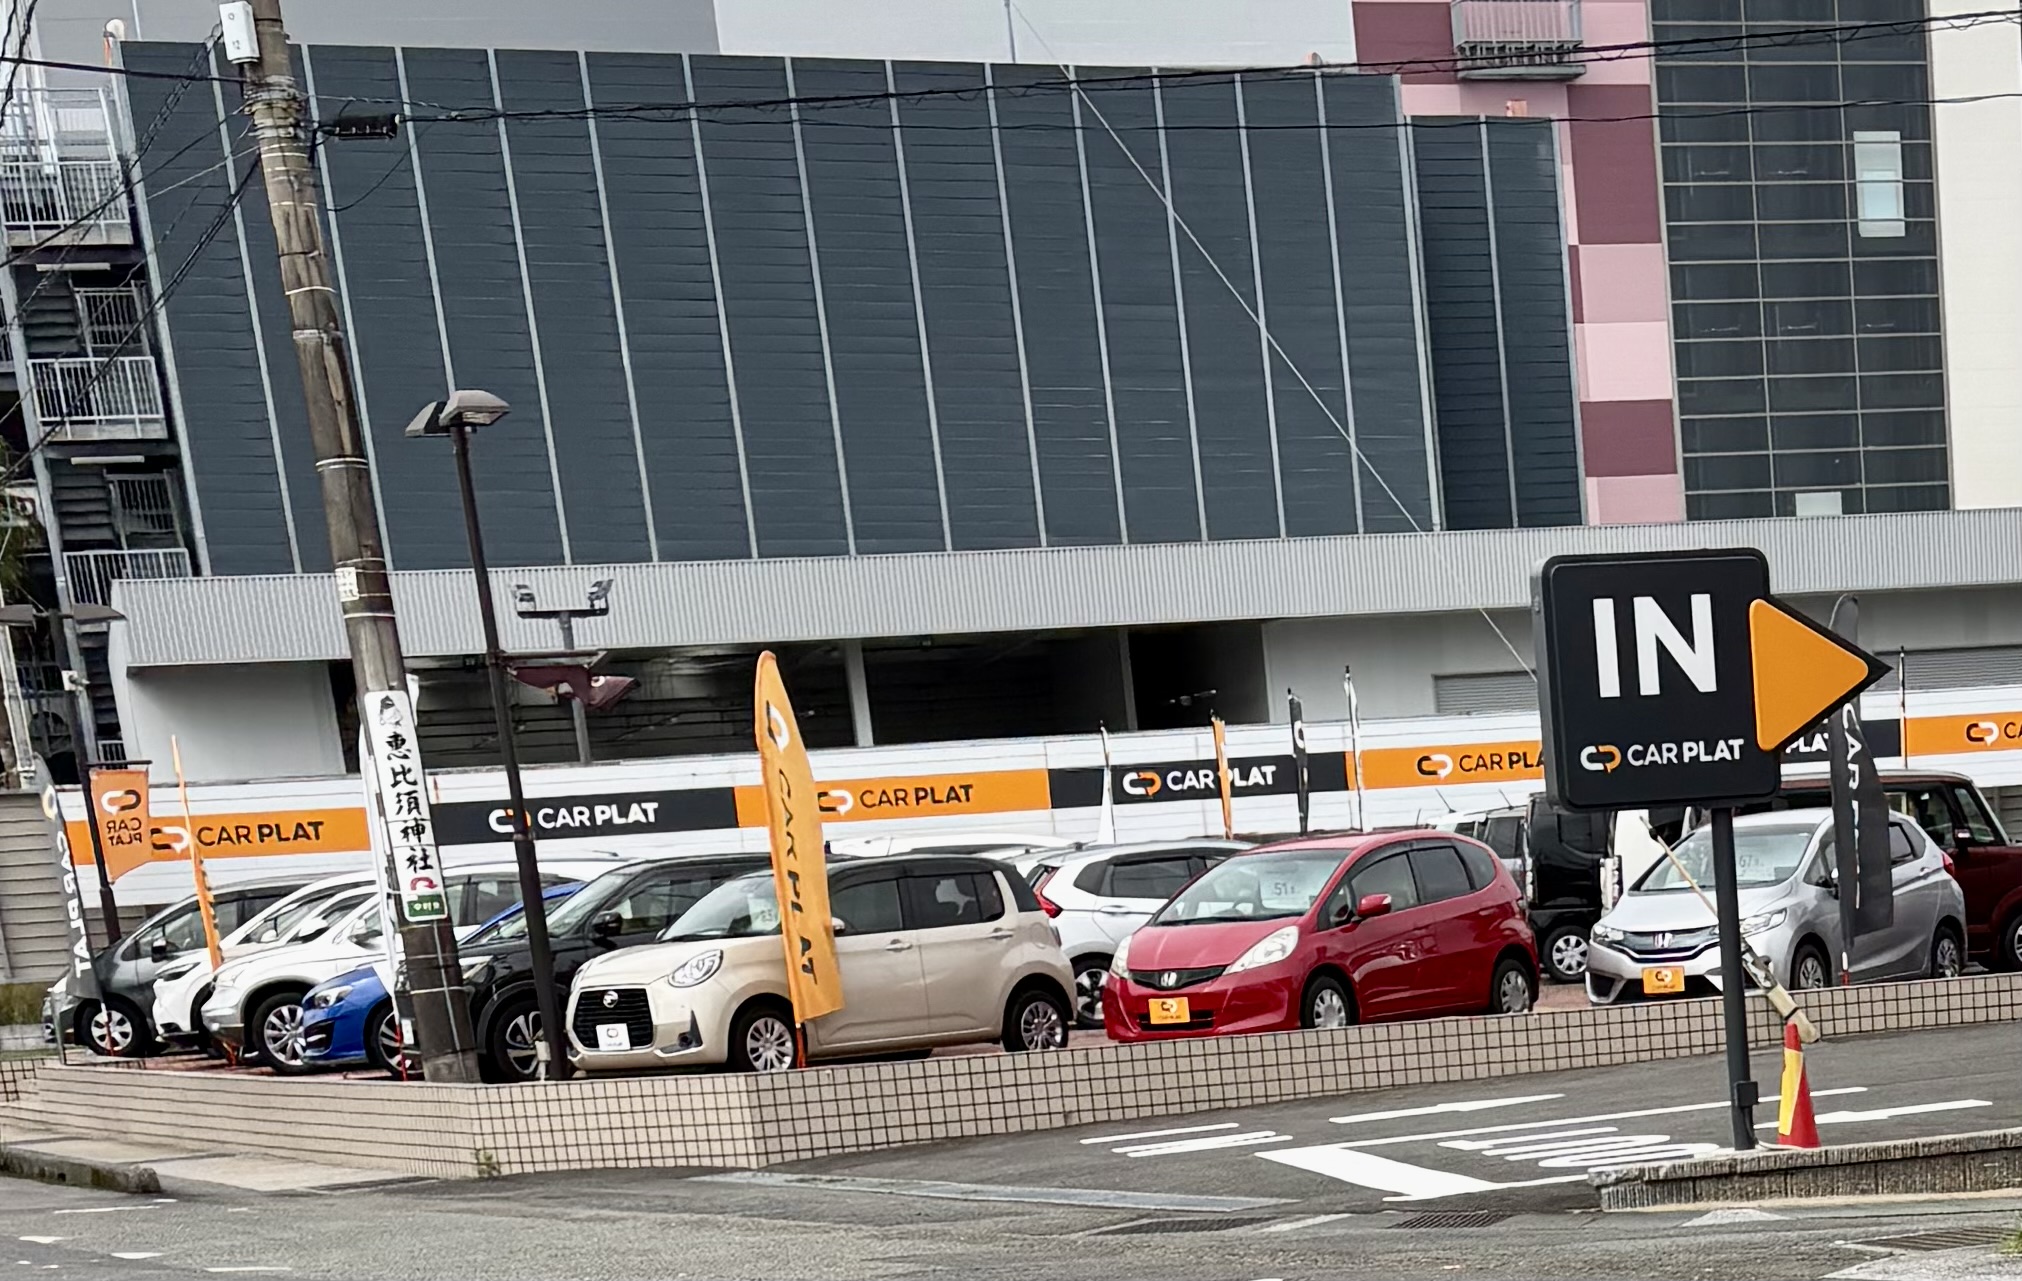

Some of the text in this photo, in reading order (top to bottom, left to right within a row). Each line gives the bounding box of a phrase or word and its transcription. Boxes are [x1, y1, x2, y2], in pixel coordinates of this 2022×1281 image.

[1592, 593, 1717, 698] IN
[1459, 754, 1503, 772] CAR
[1627, 738, 1744, 766] CAR PLAT
[1166, 769, 1215, 791] CAR
[386, 731, 434, 873] 恵比須神社
[860, 784, 973, 808] CAR PLAT
[537, 802, 659, 829] CAR PLAT
[196, 821, 324, 846] CAR PLAT
